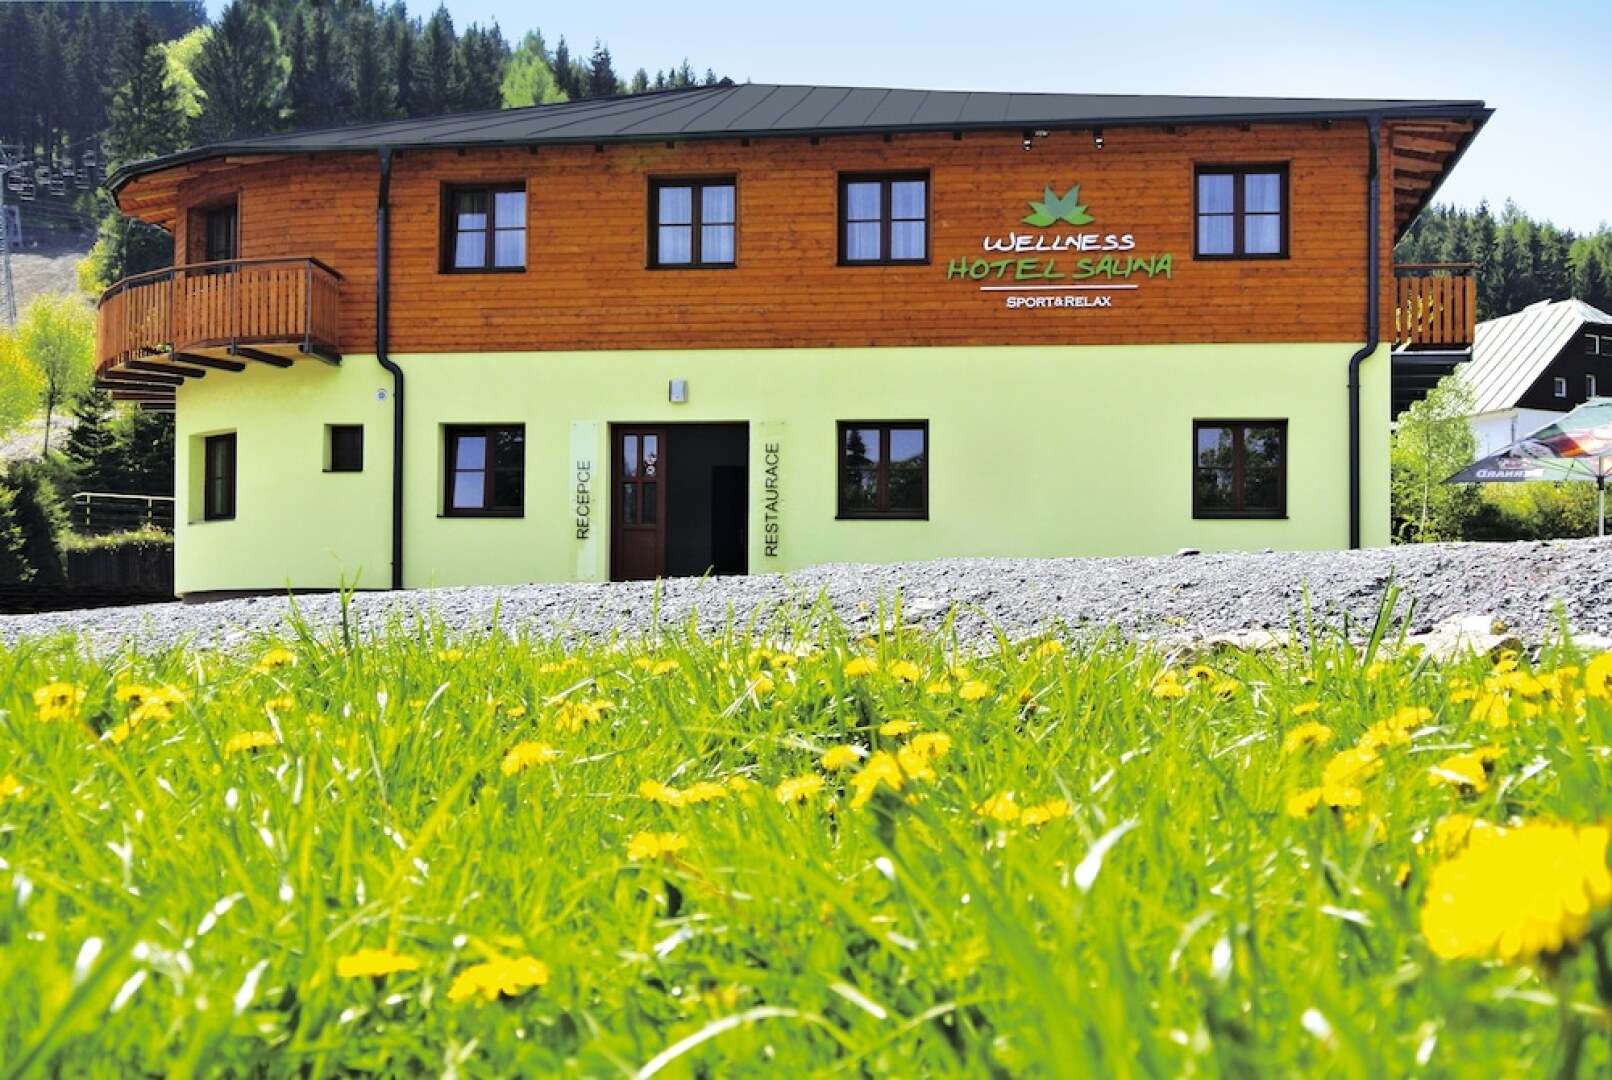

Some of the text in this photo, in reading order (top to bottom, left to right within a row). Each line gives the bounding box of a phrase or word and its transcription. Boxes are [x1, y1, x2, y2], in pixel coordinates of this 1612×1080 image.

[947, 252, 1174, 280] HOTEL SAUNA
[983, 231, 1136, 252] WELLNESS
[576, 459, 591, 540] RECEPCE
[763, 442, 780, 558] RESTAURACE
